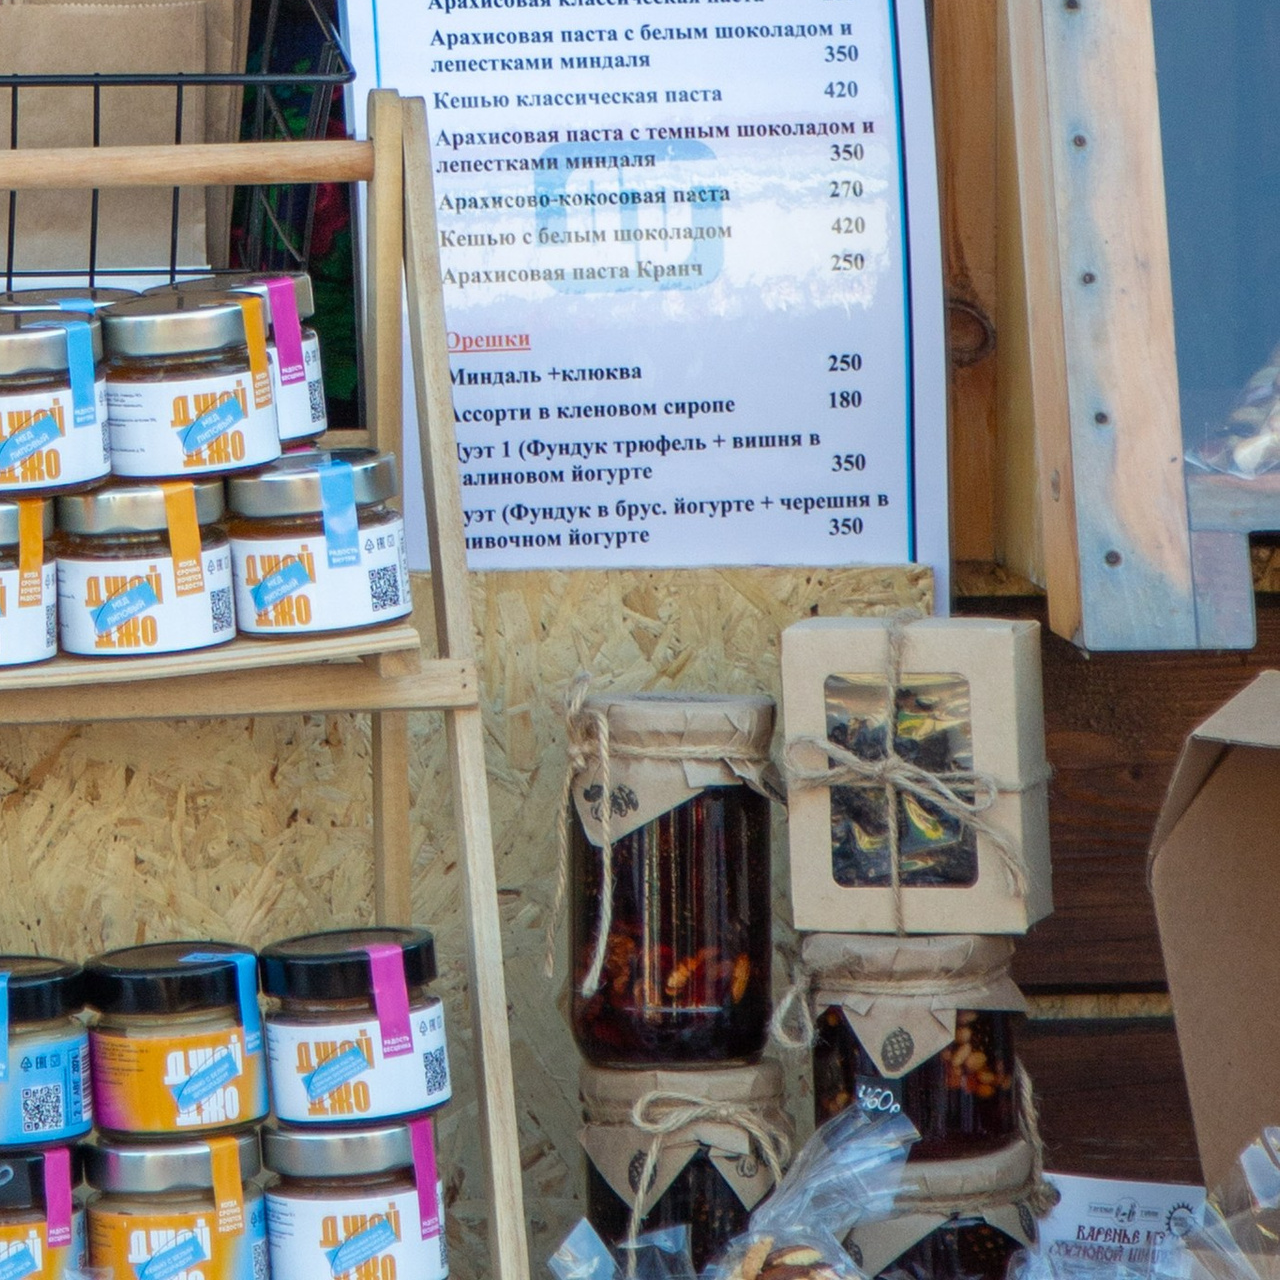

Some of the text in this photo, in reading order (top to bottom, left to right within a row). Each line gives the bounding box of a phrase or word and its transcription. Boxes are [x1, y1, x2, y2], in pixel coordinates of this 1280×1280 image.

[430, 20, 852, 48] Арахисовая паста с белым шоколадом и
[431, 45, 858, 73] лепестками миндаля 350
[434, 81, 858, 109] Кешью классическая паста 420
[436, 119, 874, 149] Арахисовая паста с темным шоколадом и
[436, 145, 864, 175] лепестками миндаля 350
[438, 181, 864, 212] Арахисово-кокосовая паста 270
[440, 217, 866, 247] Кешью с белым шоколадом 420
[442, 253, 864, 285] Арахисовая паста Кранч 250
[446, 331, 530, 349] Орешки
[450, 354, 862, 387] Миндаль +клюква 250
[540, 405, 550, 418] в
[556, 398, 656, 420] кленовом
[664, 399, 736, 418] сиропе
[828, 391, 862, 409] 180
[456, 443, 495, 462] уэт
[503, 441, 510, 457] 1
[519, 437, 607, 461] (Фундук
[614, 433, 706, 456] трюфель
[732, 433, 802, 449] вишня
[809, 431, 820, 445] в
[461, 454, 866, 487] алиновом йогурте 350
[464, 505, 495, 527] уэт
[502, 501, 590, 524] (Фундук
[598, 505, 608, 517] в
[616, 498, 666, 519] брус.
[674, 494, 755, 517] йогурте
[780, 493, 870, 512] черешня
[878, 493, 889, 507] в
[464, 517, 863, 550] ивочном йогурте 350
